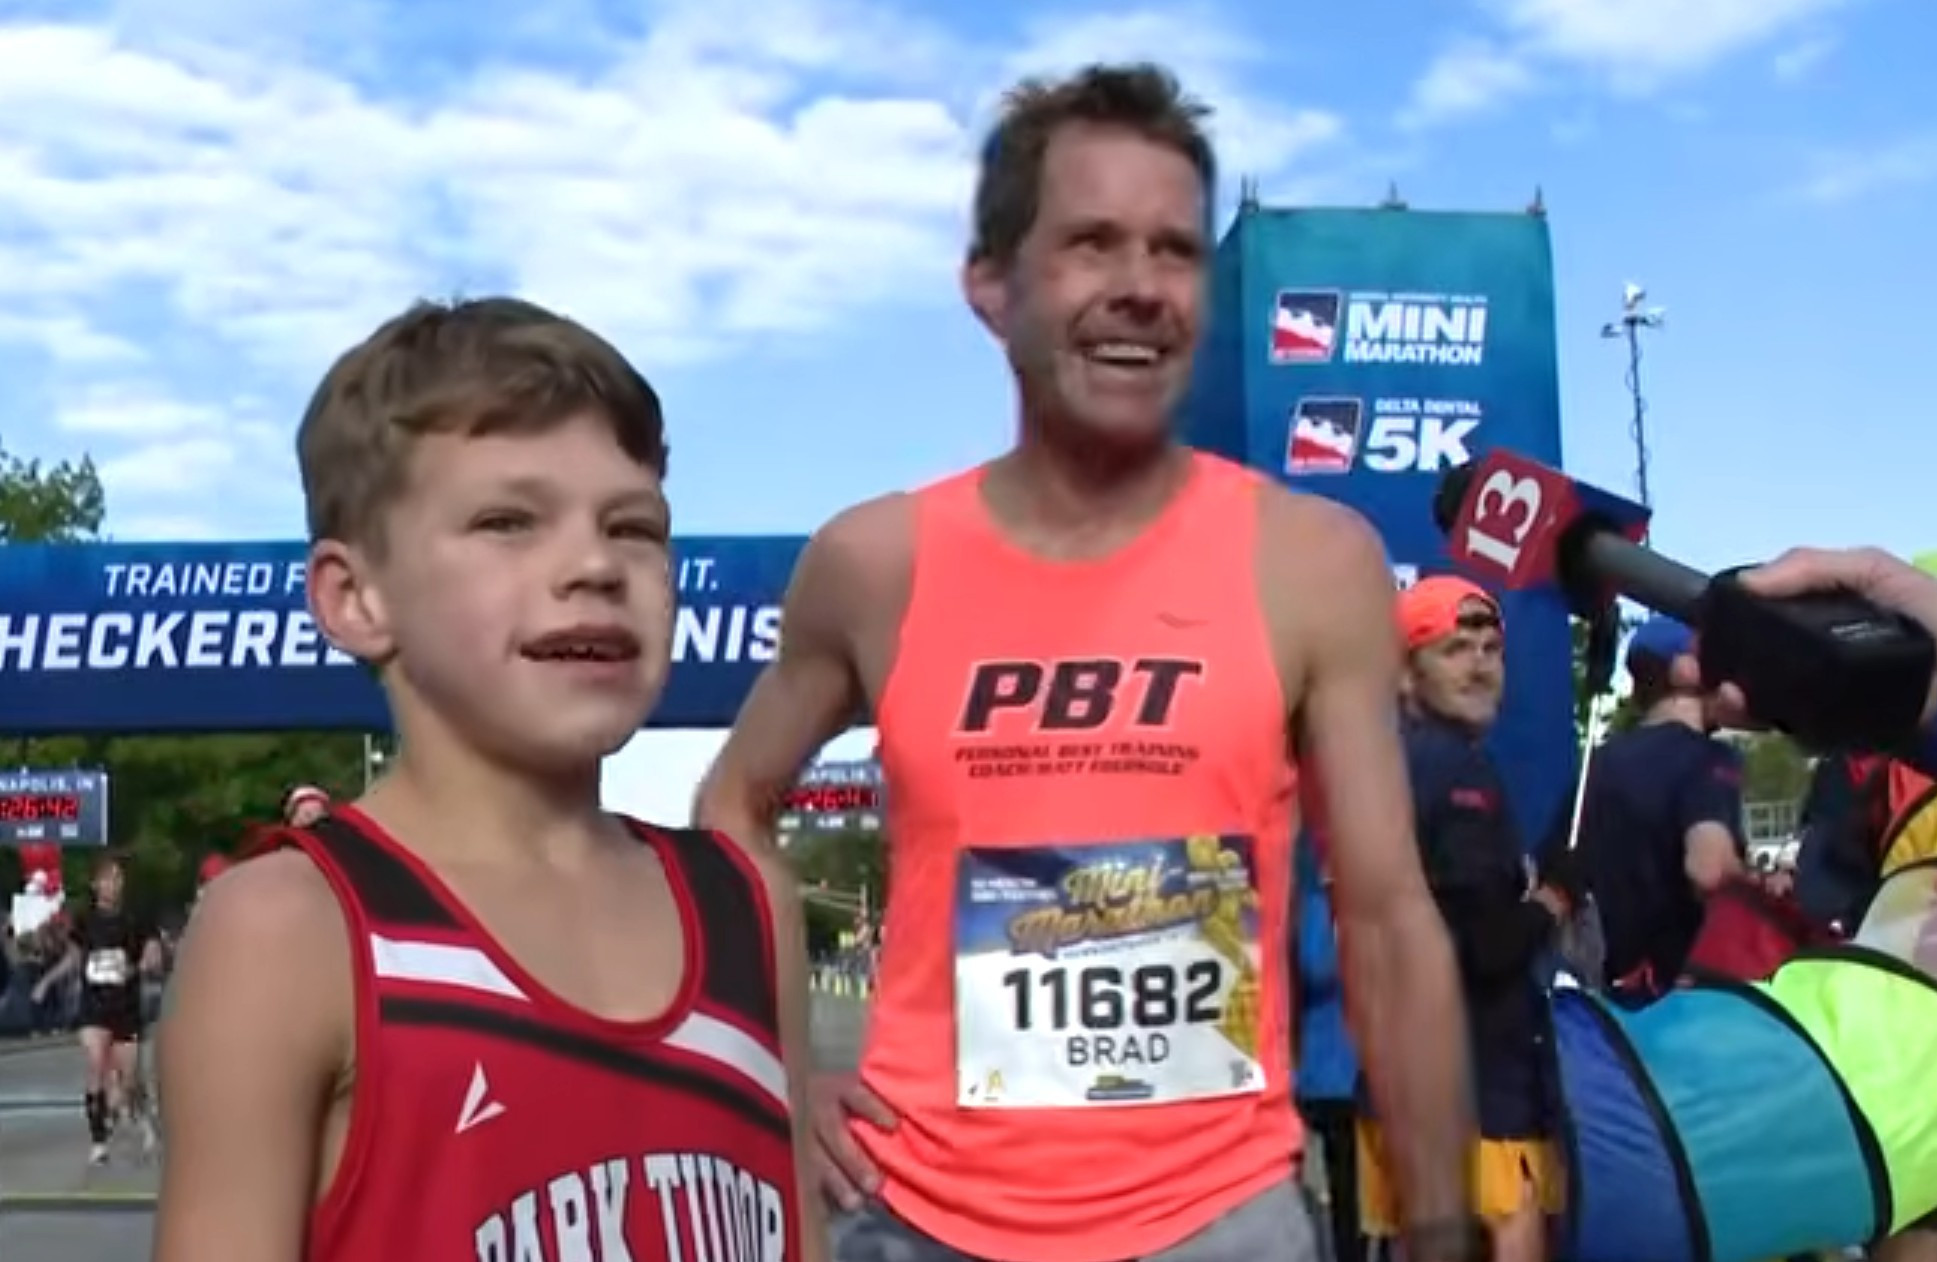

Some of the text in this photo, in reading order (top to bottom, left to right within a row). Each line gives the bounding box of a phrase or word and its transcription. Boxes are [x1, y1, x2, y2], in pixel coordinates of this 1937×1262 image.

[1349, 302, 1487, 342] MINI
[1344, 342, 1482, 365] MARATHON
[1374, 398, 1481, 415] DELTA DENTAL
[1363, 416, 1479, 471] 5K
[1466, 469, 1542, 573] 13
[104, 561, 273, 597] TRAINED
[960, 657, 1203, 733] PBT
[1003, 958, 1222, 1031] 11682
[1066, 1033, 1170, 1066] BRAD
